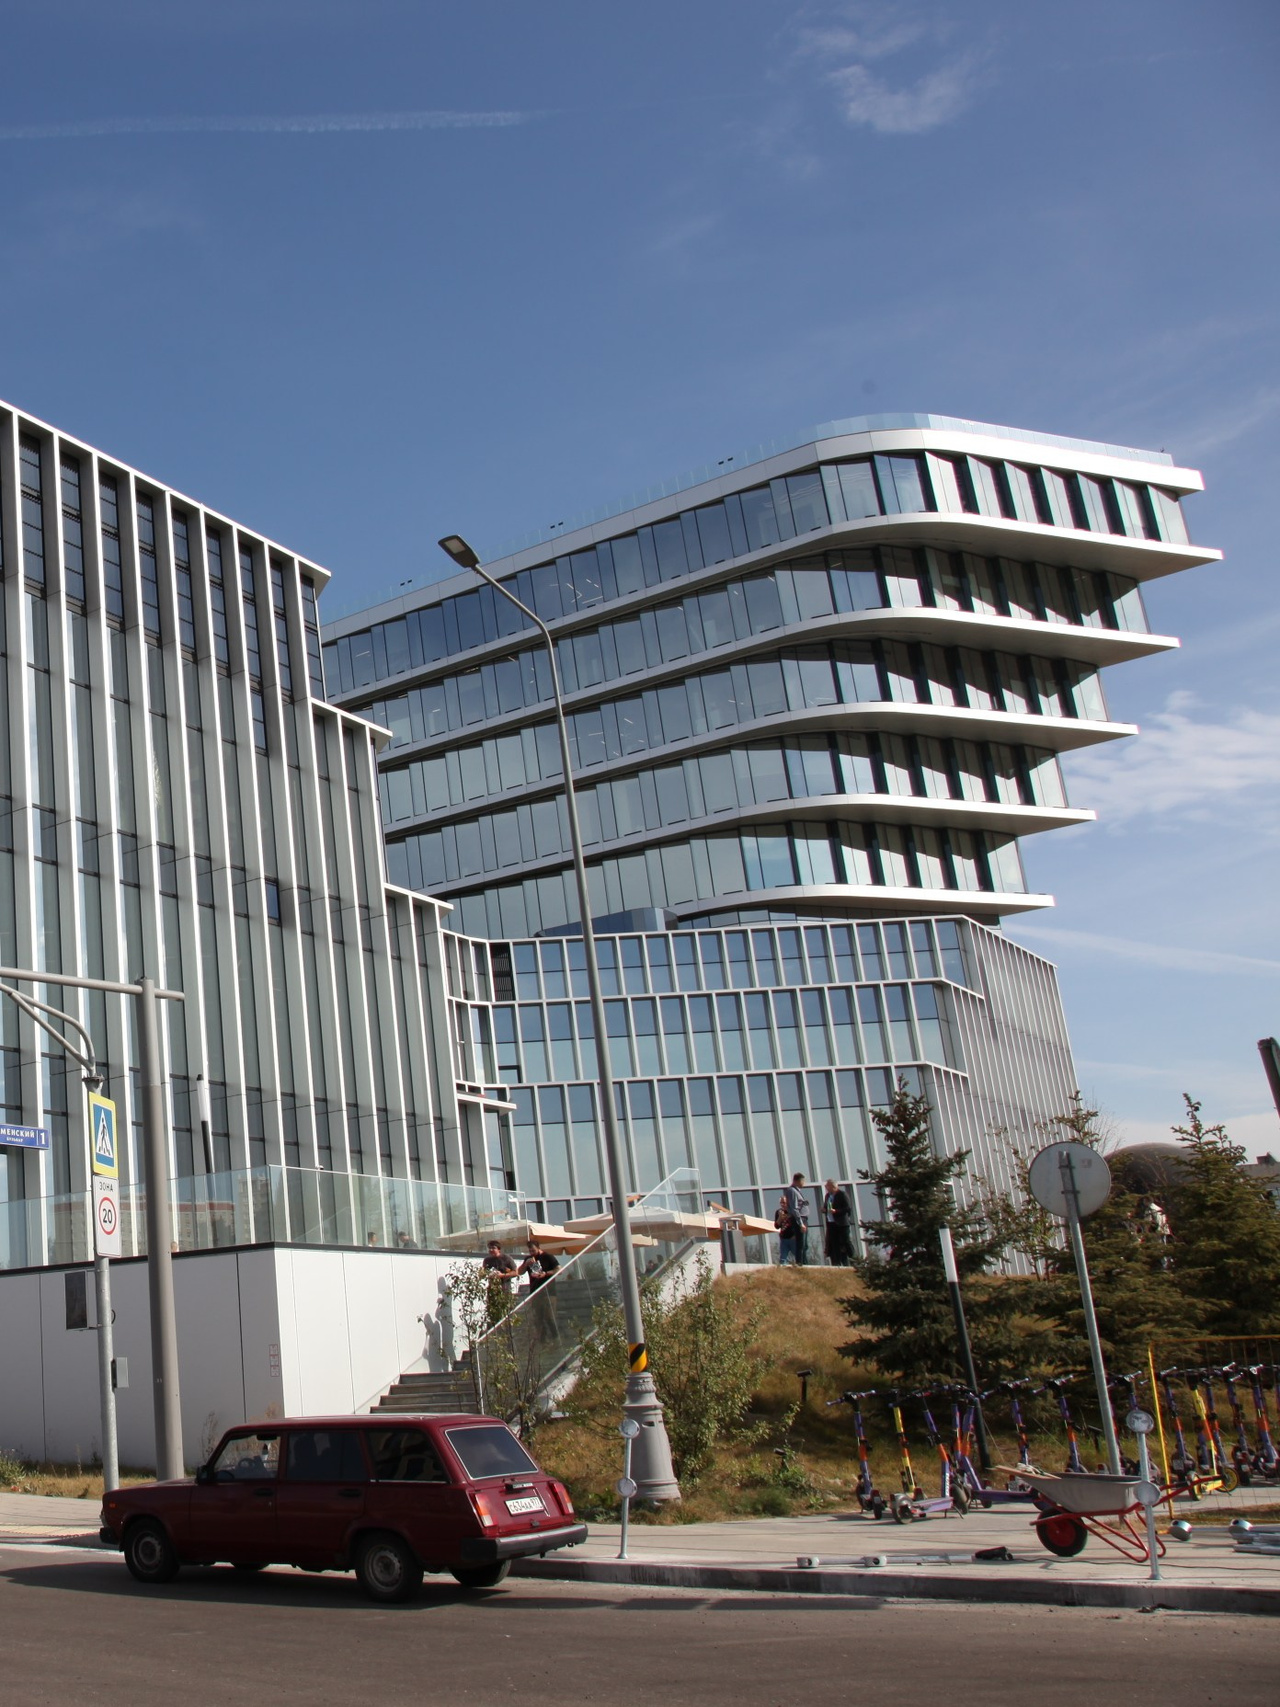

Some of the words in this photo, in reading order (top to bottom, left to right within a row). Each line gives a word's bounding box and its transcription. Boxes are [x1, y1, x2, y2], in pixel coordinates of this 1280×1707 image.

[40, 1132, 46, 1145] 1
[99, 1181, 114, 1193] ЗОНА
[102, 1208, 113, 1224] 20
